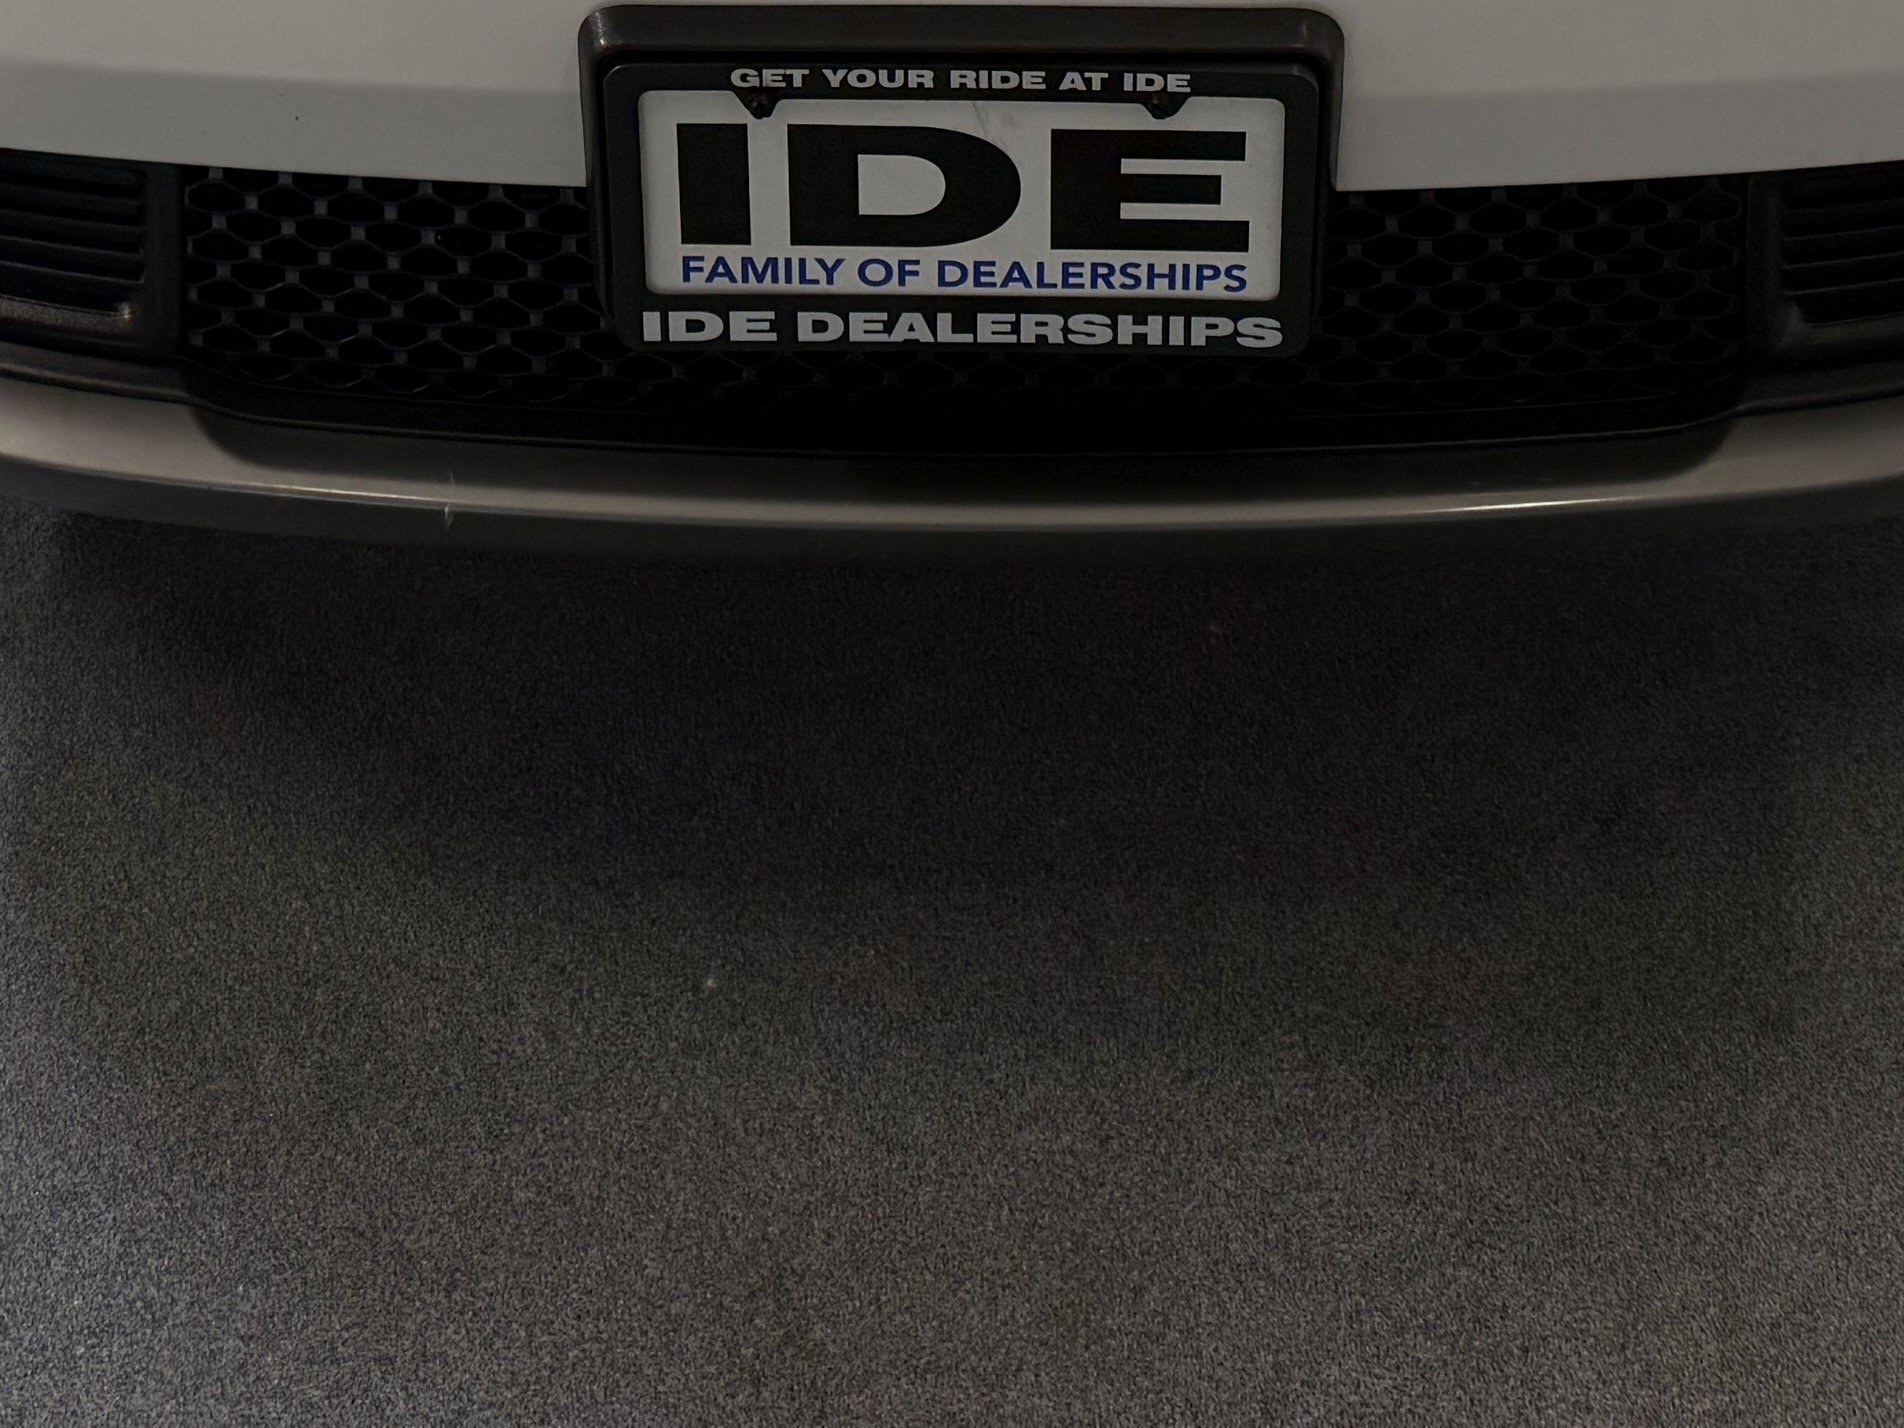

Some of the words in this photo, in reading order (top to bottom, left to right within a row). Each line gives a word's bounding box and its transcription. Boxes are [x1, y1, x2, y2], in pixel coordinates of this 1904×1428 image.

[730, 68, 809, 88] GET
[823, 69, 934, 88] YOUR
[951, 70, 1045, 90] RIDE
[1060, 71, 1108, 91] AT
[1124, 72, 1191, 93] IDE
[676, 122, 1251, 254] IDE
[682, 254, 845, 286] FAMILY
[858, 258, 920, 288] OF
[937, 259, 1248, 293] DEALERSHIPS
[642, 311, 778, 342] IDE
[797, 311, 1283, 348] DEALERSHIPS
